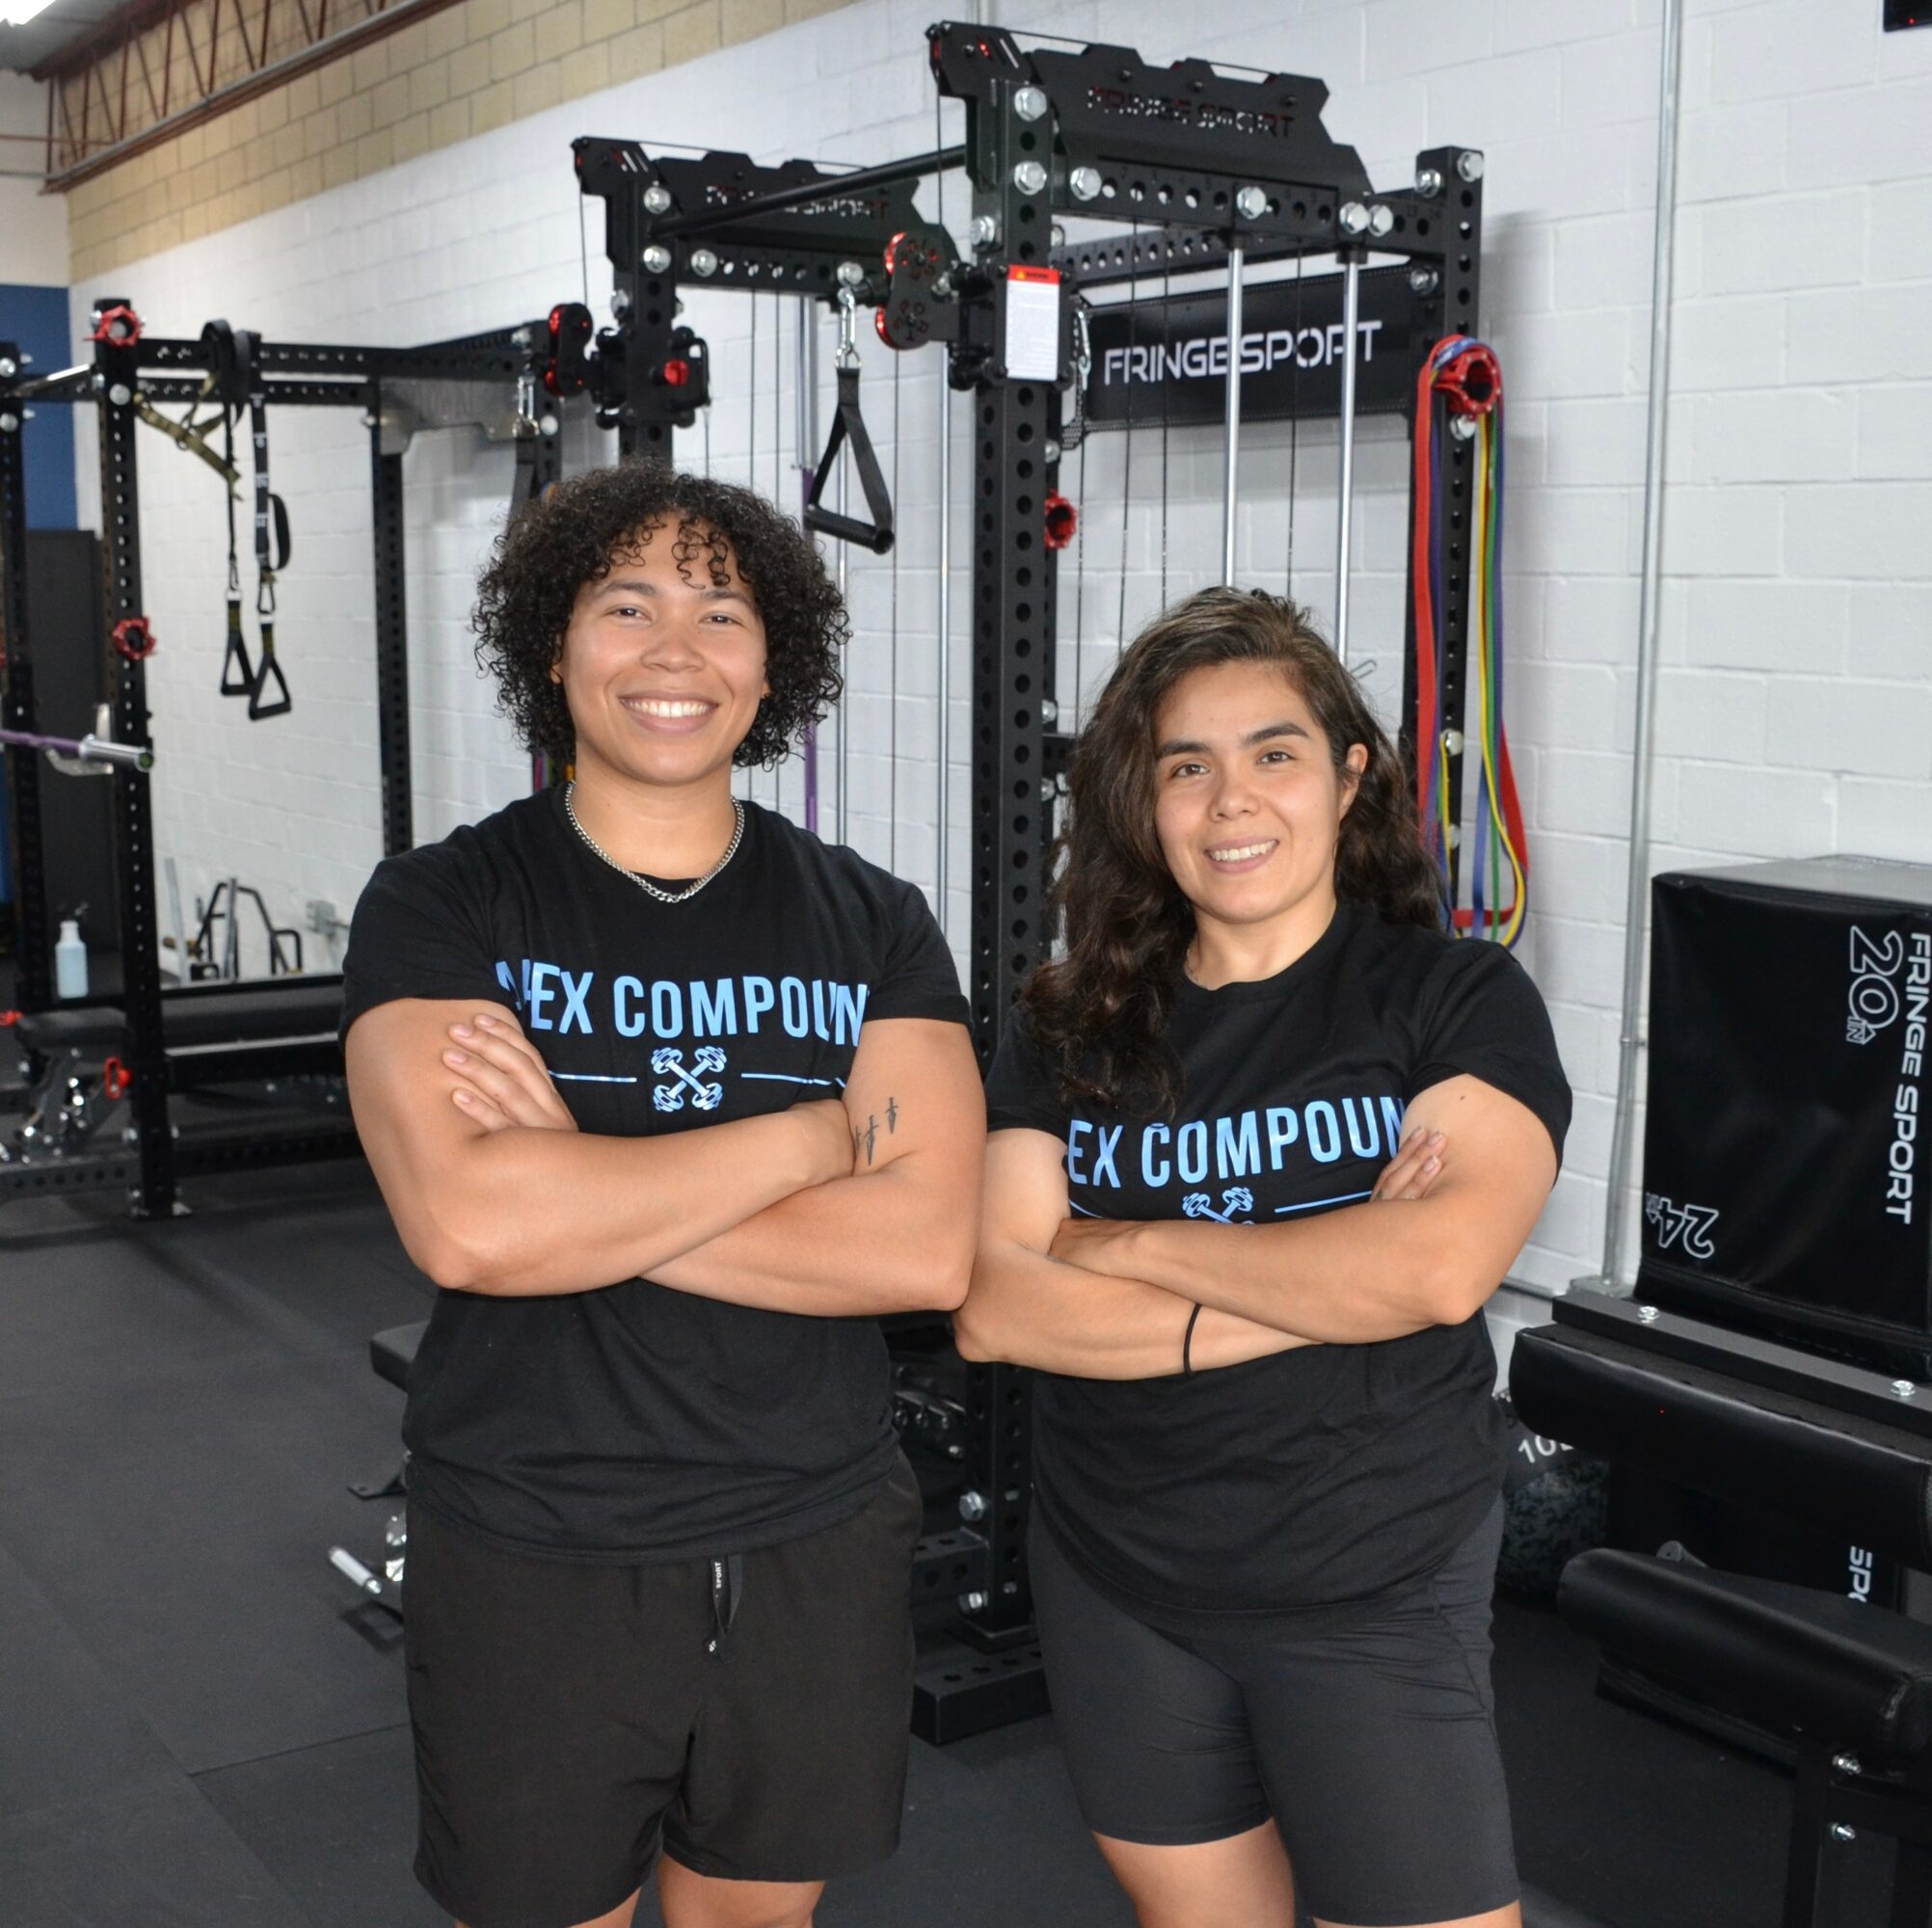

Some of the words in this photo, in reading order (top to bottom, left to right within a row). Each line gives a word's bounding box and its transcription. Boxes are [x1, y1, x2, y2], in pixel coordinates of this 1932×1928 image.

[612, 975, 870, 1047] COMPOUN
[1847, 924, 1904, 1030] 20
[1900, 932, 1931, 1078] FRINGE
[1064, 1119, 1124, 1189] EX
[1140, 1096, 1405, 1189] COMPOUN
[1885, 1083, 1919, 1225] SPORT
[1517, 1434, 1573, 1463] 10
